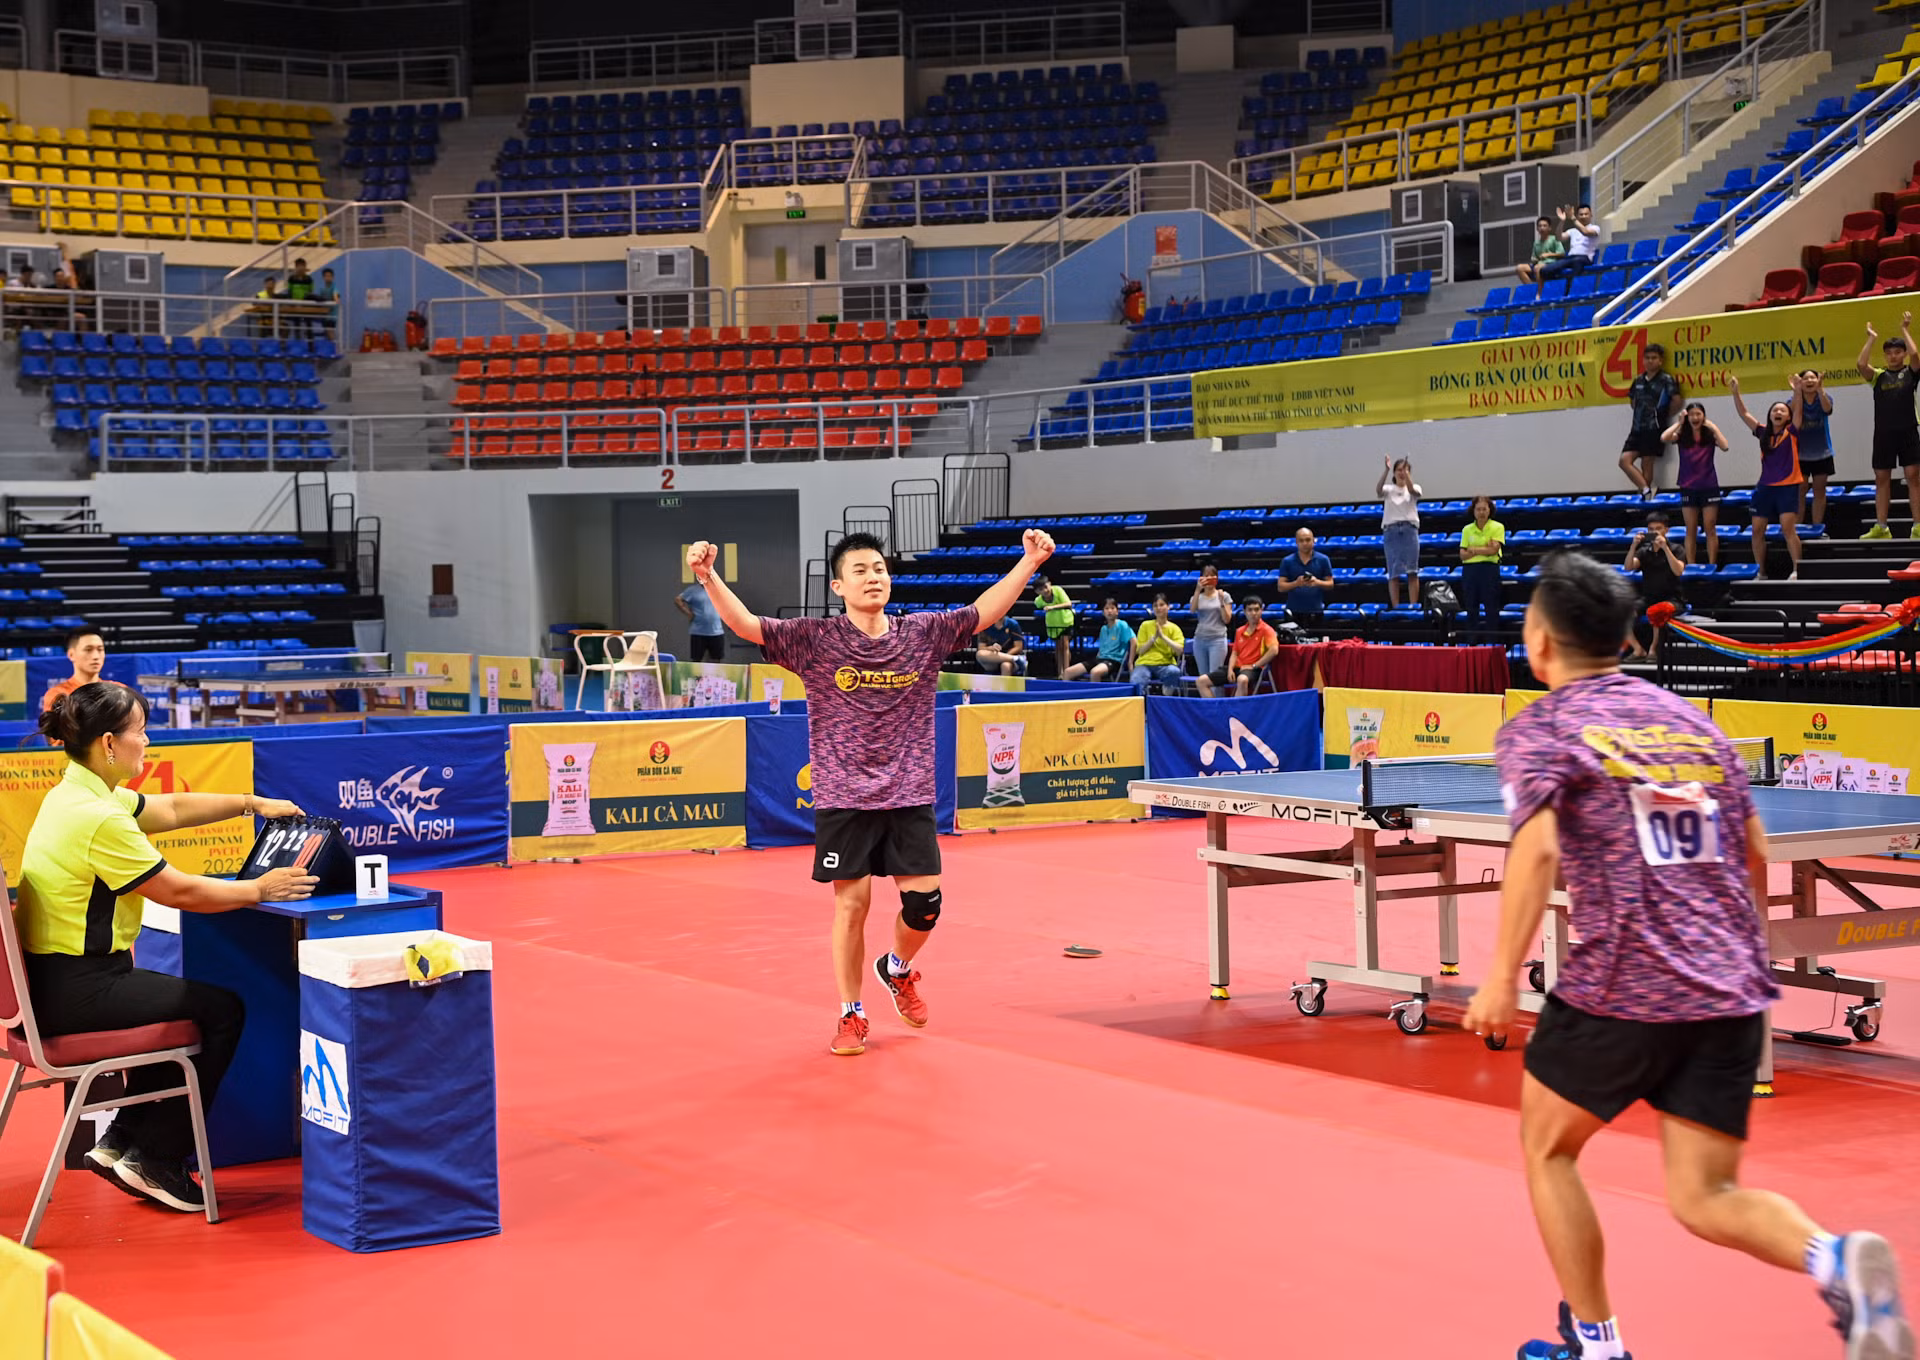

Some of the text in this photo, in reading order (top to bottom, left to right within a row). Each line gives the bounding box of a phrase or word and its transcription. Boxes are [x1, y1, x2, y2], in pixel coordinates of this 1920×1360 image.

[1674, 322, 1711, 345] CÚP
[1519, 343, 1541, 361] VÔ
[1607, 328, 1648, 380] 41
[1674, 336, 1825, 368] PETROVIETNAM
[1430, 360, 1587, 391] BÓNG BÀN QUỐC GIA
[1675, 369, 1731, 390] PVCFC
[1845, 368, 1861, 378] NIN
[1335, 386, 1355, 397] NAM
[1469, 382, 1585, 409] BÁO NHÂN DÂN
[1344, 402, 1366, 413] NINH
[661, 469, 675, 490] 2
[660, 497, 681, 507] EXIT
[993, 751, 1015, 763] NPK
[1044, 750, 1120, 768] NPK CÀ MAU
[557, 784, 582, 793] KALI
[1813, 775, 1832, 784] NPK
[1172, 796, 1197, 808] DOUBLE
[1197, 800, 1211, 809] FISH
[605, 802, 726, 825] KALI CÀ MAU
[1272, 803, 1359, 827] MOFIT
[156, 835, 243, 849] PETROVIETNAM
[342, 818, 455, 847] OUBLE FISH
[209, 847, 242, 857] PVCFC
[256, 829, 286, 867] 12
[203, 857, 245, 874] 2023
[364, 863, 382, 888] T
[1836, 920, 1908, 945] DOUBLE
[303, 1103, 348, 1131] MOFIT
